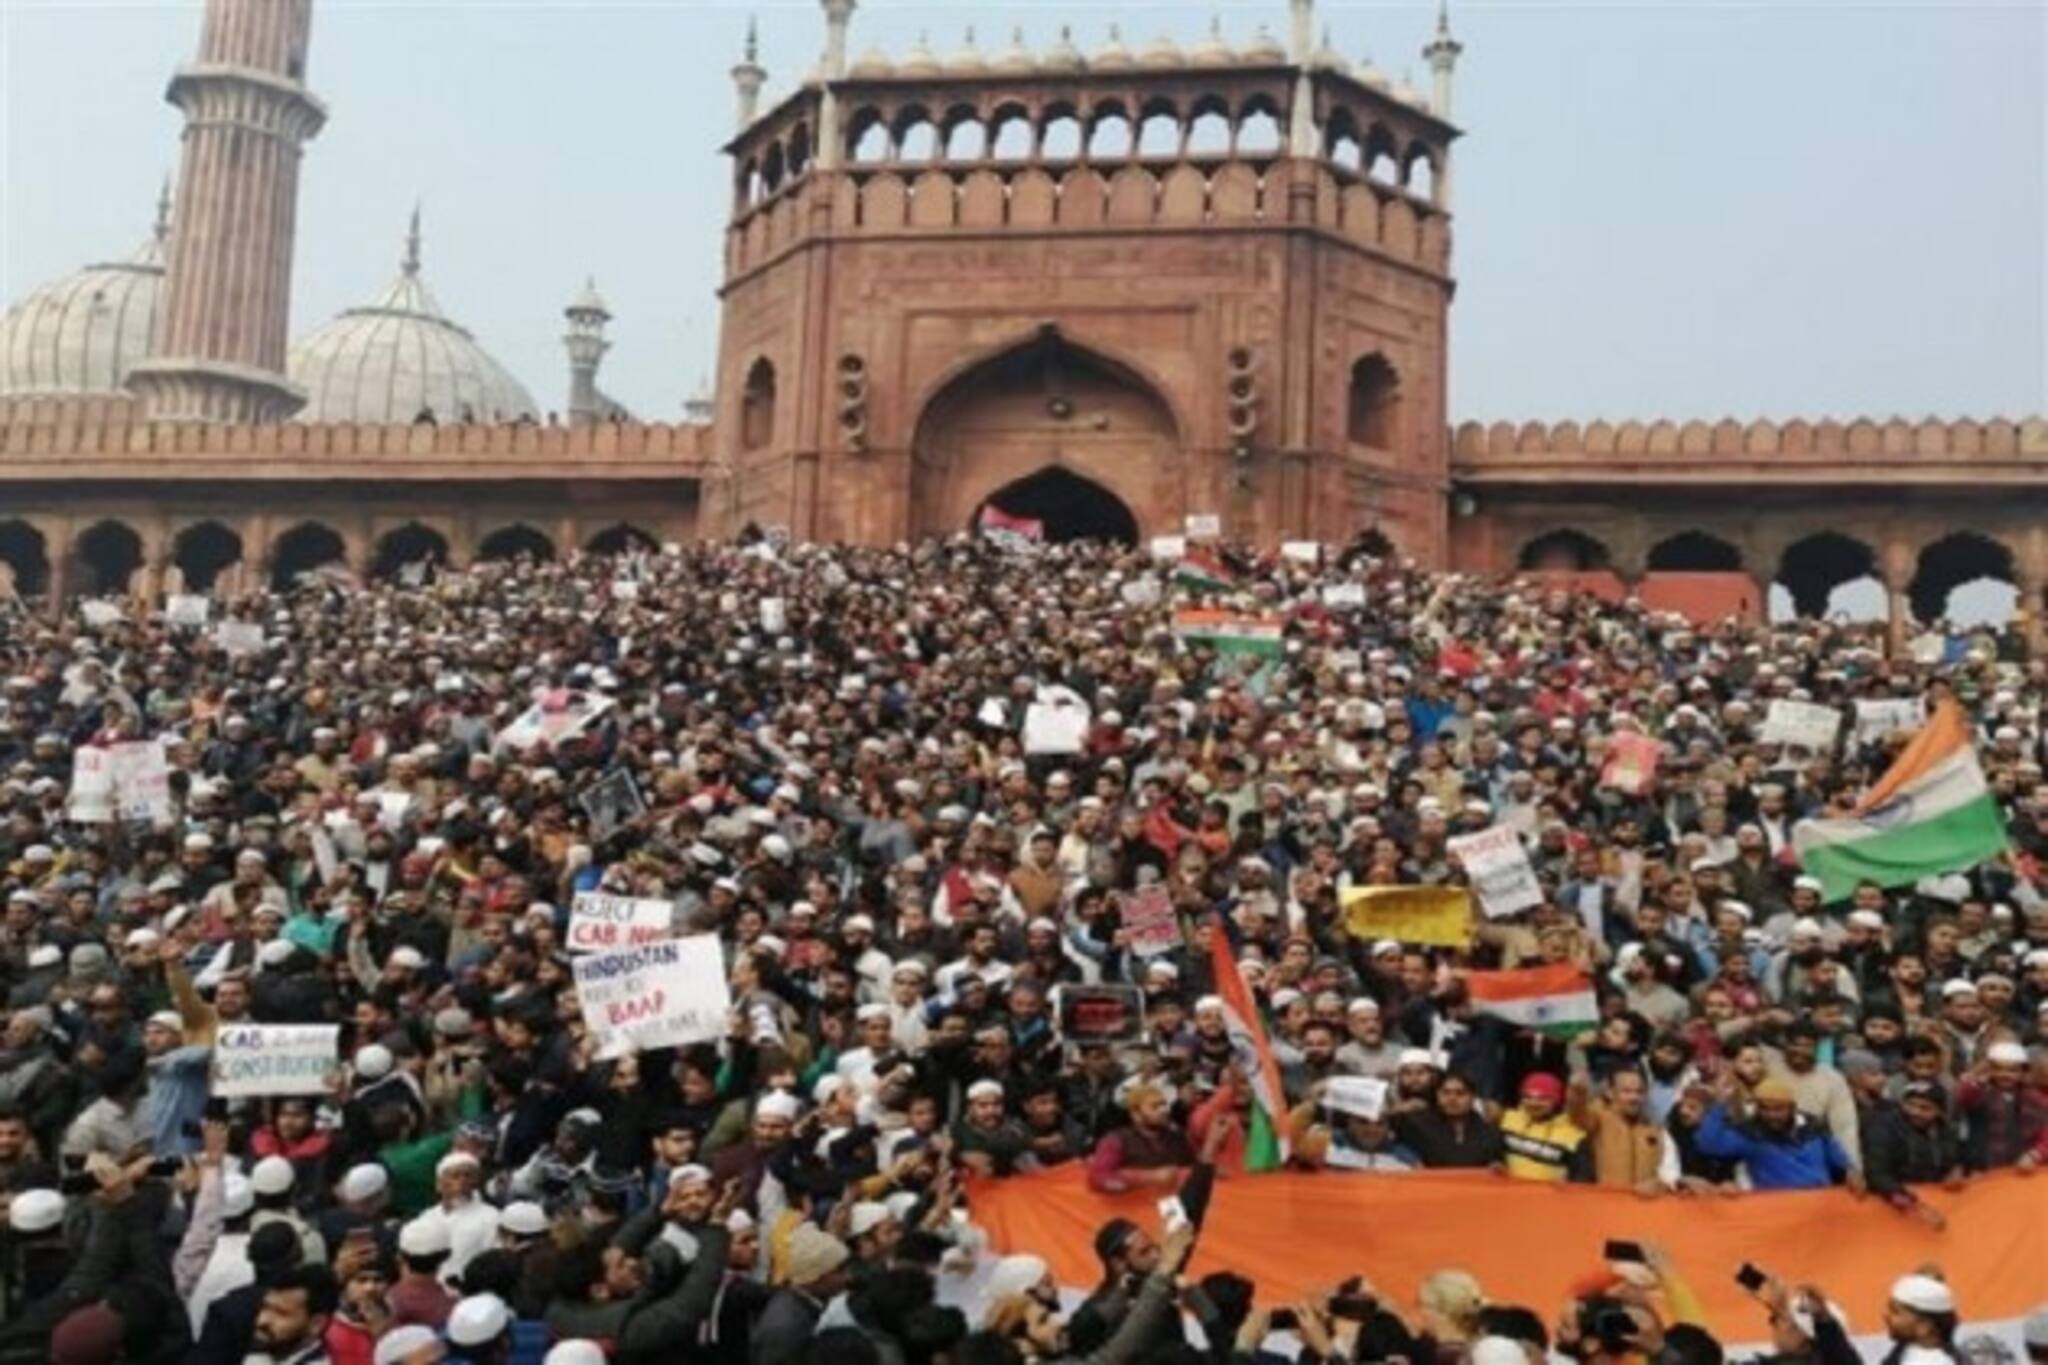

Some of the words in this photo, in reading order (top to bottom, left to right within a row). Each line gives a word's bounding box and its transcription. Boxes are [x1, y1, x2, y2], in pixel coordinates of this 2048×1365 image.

[574, 922, 617, 946] CAB
[576, 943, 680, 980] HINDUSTAN
[606, 989, 665, 1026] BAAP
[220, 1029, 264, 1052] CAB
